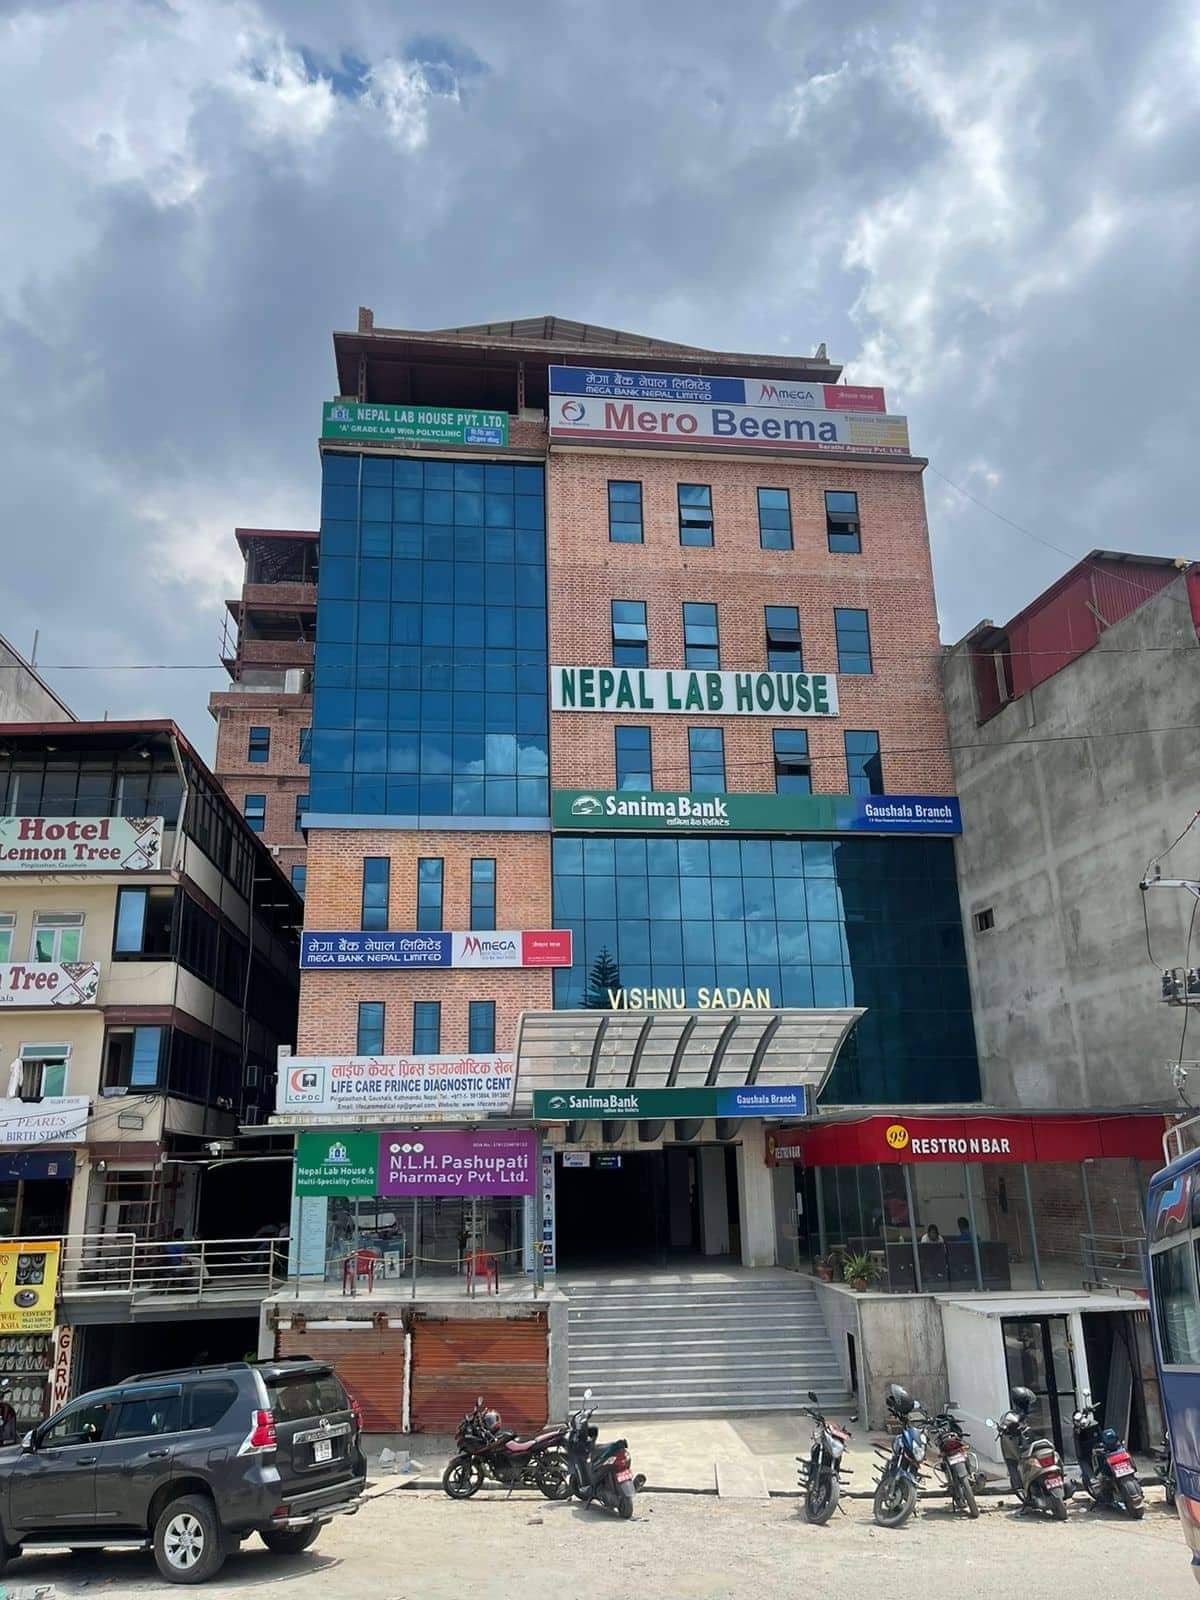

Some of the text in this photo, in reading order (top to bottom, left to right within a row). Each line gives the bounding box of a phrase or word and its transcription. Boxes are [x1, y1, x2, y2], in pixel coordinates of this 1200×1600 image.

[586, 372, 711, 391] मेगा बैंक नेपाल लिमिटेड
[586, 386, 712, 400] MEGA BANK NEPAL LIMITED
[357, 408, 505, 428] NEPAL LAB HOUSE PVT. LTD.
[604, 402, 698, 433] Mero
[712, 408, 838, 442] Beema
[351, 424, 378, 433] GRADE
[379, 426, 396, 434] LAB
[416, 428, 462, 437] POLYCLINIC
[561, 668, 829, 713] NEPAL LAB HOUSE
[865, 804, 952, 818] Gaushala Branch
[17, 818, 110, 841] Hotel
[0, 843, 121, 861] Lemon Tree
[308, 937, 442, 951] मेगा बैंक नेपाल लिमिटेड
[307, 953, 442, 962] MEGA BANK NEPAL LIMITED
[9, 966, 59, 990] Tree
[607, 988, 771, 1010] VISHNU SADAN
[368, 1060, 396, 1077] केयर
[331, 1077, 511, 1093] LIFE CARE PRINCE DIAGNOSTIC CENT
[737, 1094, 796, 1104] Gaushala Branch
[16, 1116, 67, 1127] PEARL'S
[6, 1130, 78, 1142] BIRTH STONES
[889, 1130, 907, 1145] 99
[912, 1138, 1010, 1154] RESTRO N BAR
[390, 1154, 528, 1172] N.L.H. Pashupati
[298, 1167, 375, 1176] Nepal Lab House &
[389, 1170, 529, 1185] Pharmacy Pvt. Ltd.
[298, 1177, 374, 1186] Multi-Speciality Clinics
